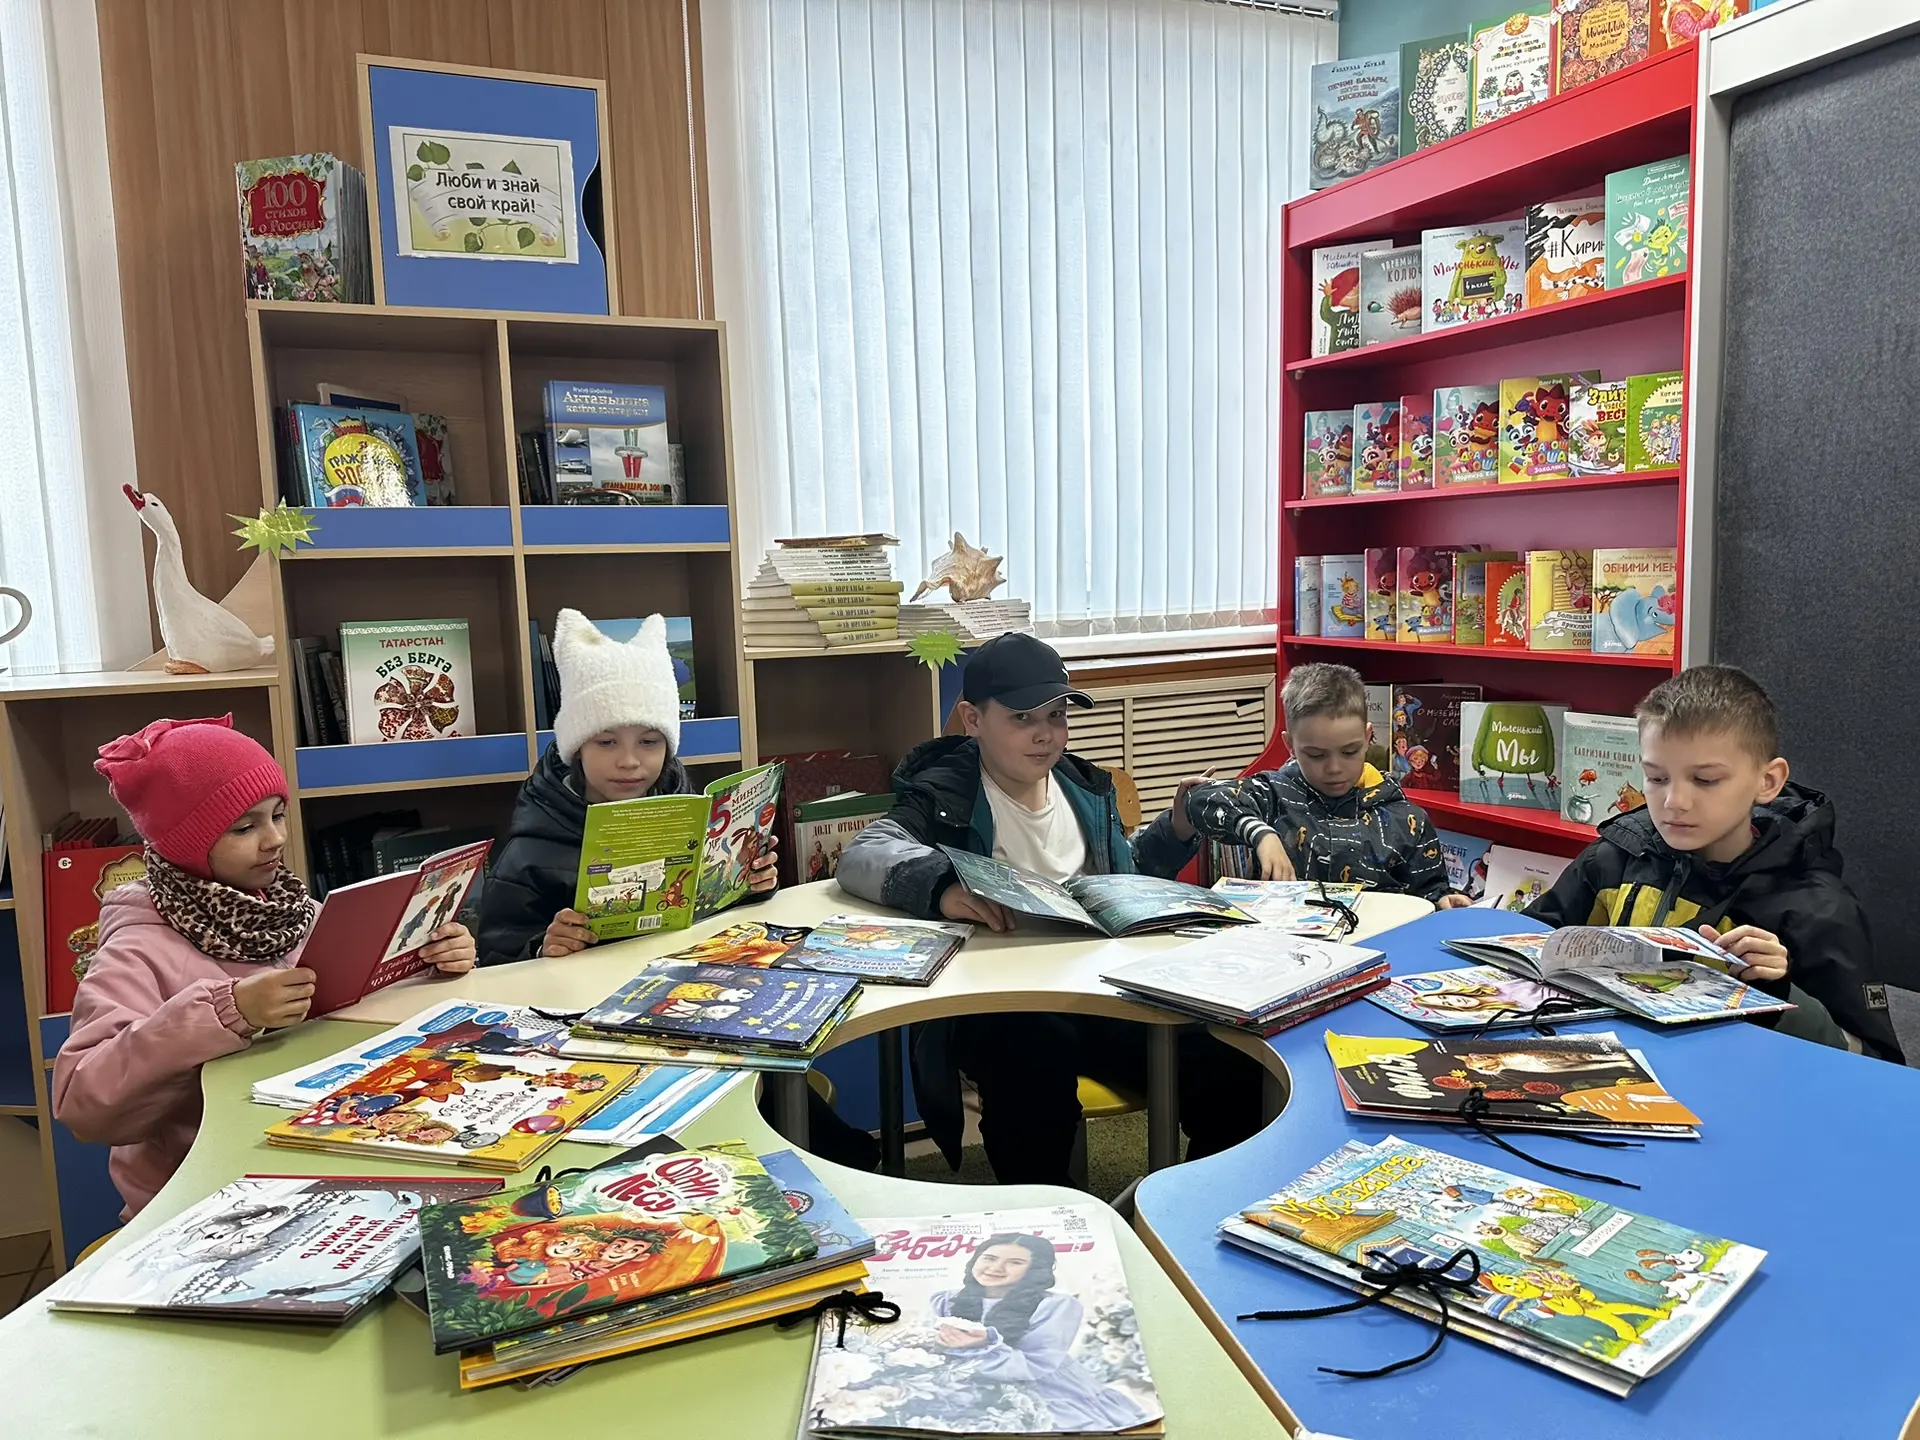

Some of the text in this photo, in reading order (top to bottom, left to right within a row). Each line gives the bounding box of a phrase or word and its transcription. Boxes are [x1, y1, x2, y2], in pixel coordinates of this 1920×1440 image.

[259, 179, 308, 209] 100
[435, 171, 541, 194] Люби и знай
[447, 194, 537, 215] свой край!
[1433, 254, 1521, 277] Маленький Мы
[601, 481, 648, 492] КТАНЫШКА
[1602, 562, 1650, 573] ОБНИМИ
[378, 636, 444, 649] ТАТАРСТАН
[375, 652, 453, 679] БЕЗ БЕРГӘ
[1491, 720, 1544, 735] Маленький
[1496, 738, 1540, 767] Мы
[709, 792, 732, 839] 5
[731, 780, 765, 807] МИНУТ
[812, 823, 833, 838] ДОЛГ
[837, 819, 865, 833] ОТВАГА
[61, 860, 72, 868] 6+
[370, 971, 395, 987] ЧУК
[599, 1172, 678, 1213] ЛЕСУ
[1268, 1153, 1426, 1224] Мурзилка
[299, 1214, 368, 1261] ДРУЖИТЬ
[327, 1219, 386, 1257] УЧИТСЯ
[332, 1243, 376, 1270] ЛАКИ
